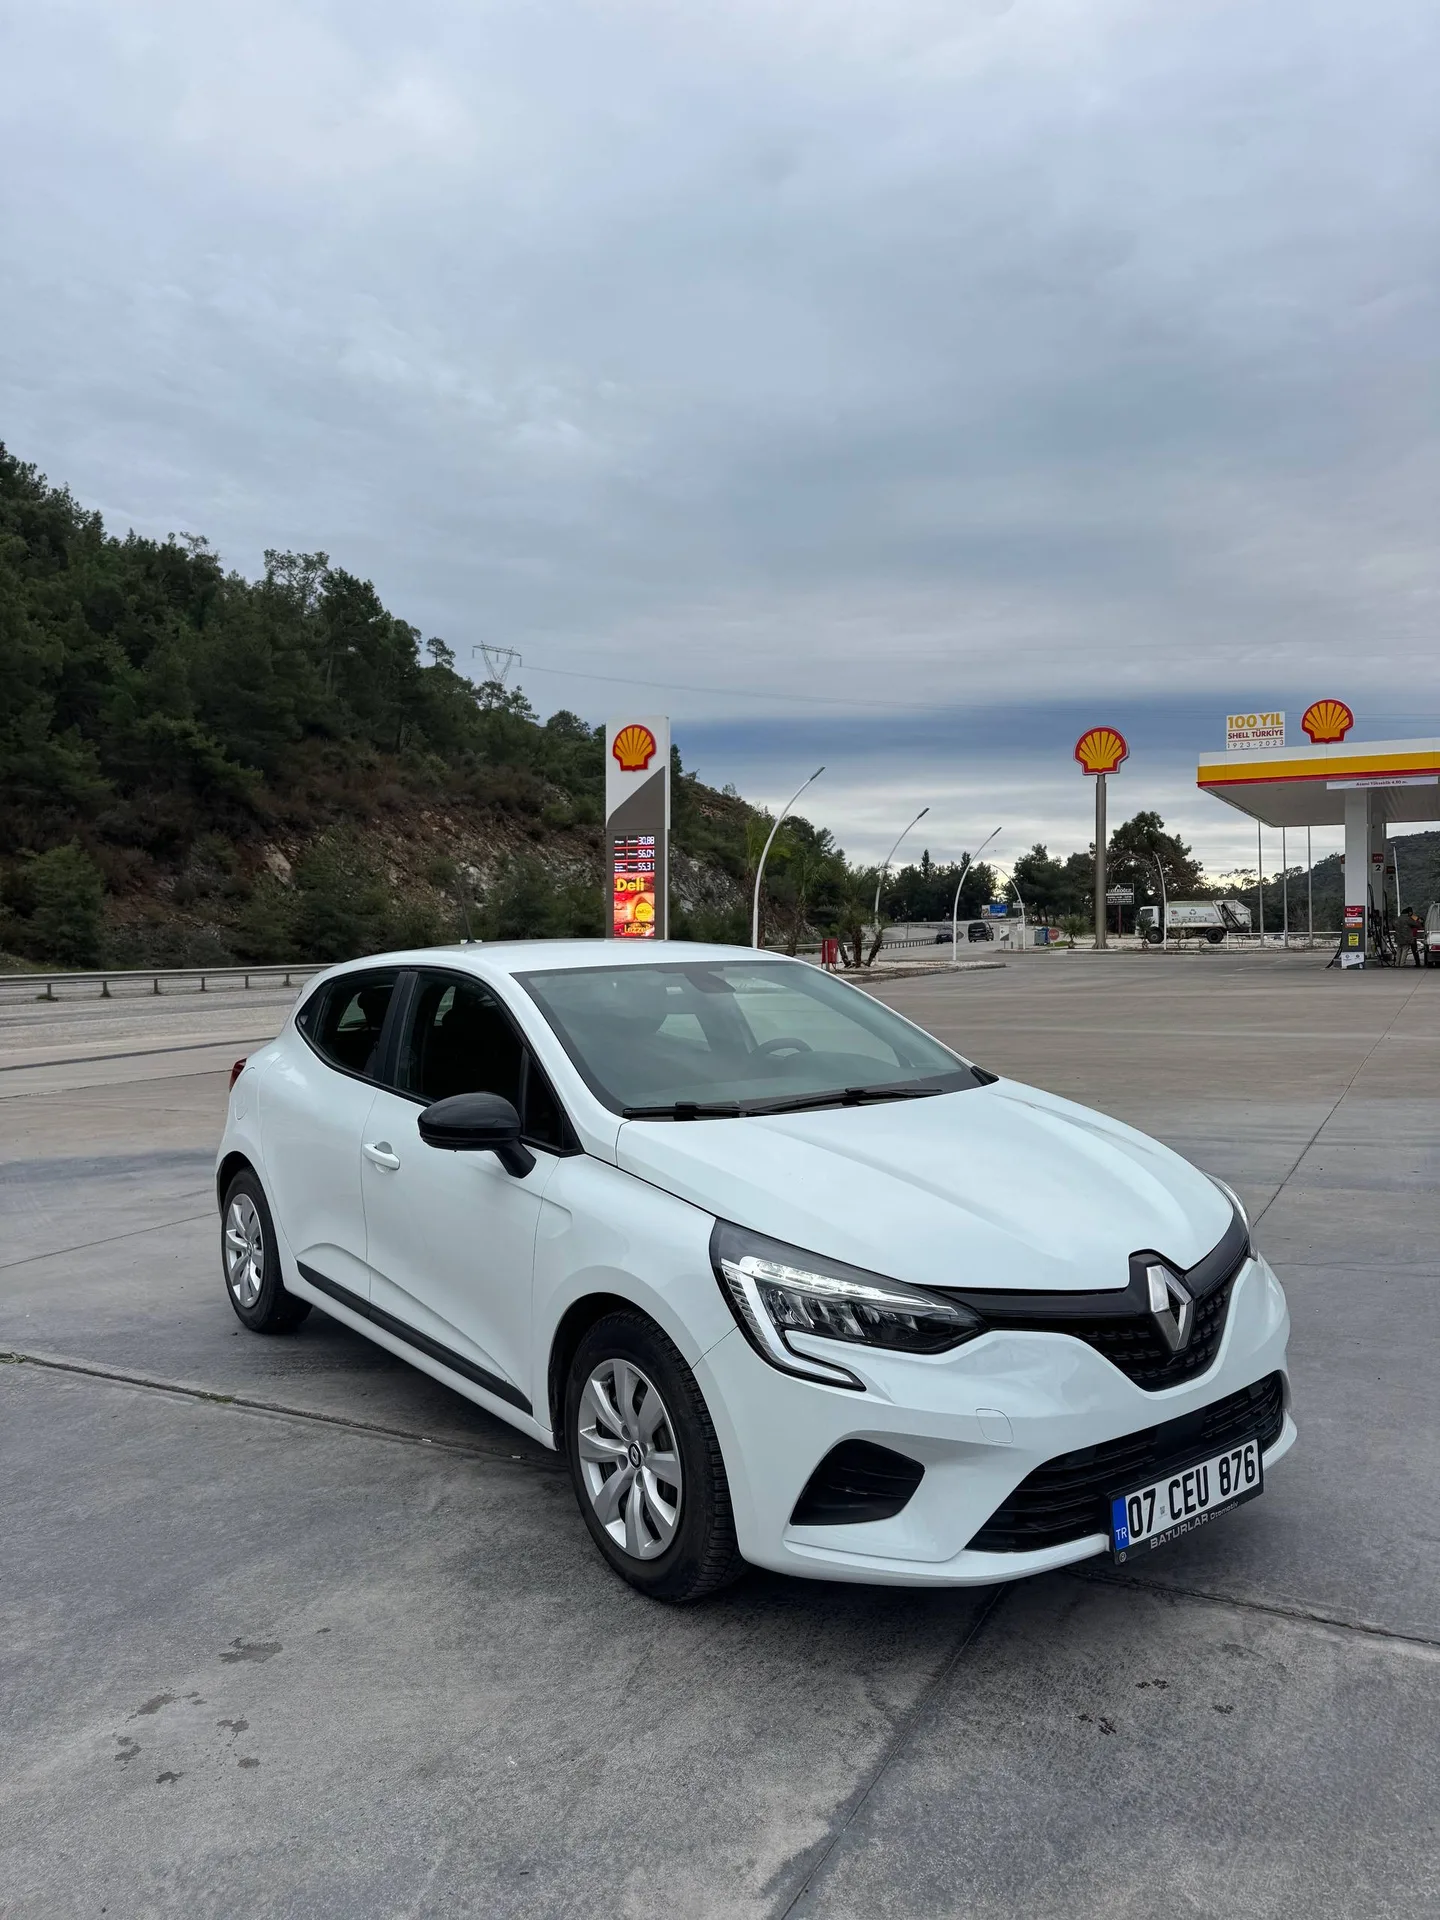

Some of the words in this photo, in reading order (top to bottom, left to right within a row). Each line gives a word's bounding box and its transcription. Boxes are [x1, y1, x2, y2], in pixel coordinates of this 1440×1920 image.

[1228, 714, 1257, 729] 100
[1259, 712, 1284, 727] YIL
[1227, 731, 1250, 740] SHELL
[1251, 727, 1284, 738] TÜRKİYE
[616, 877, 645, 892] Deli
[1128, 1487, 1156, 1539] 07
[1168, 1465, 1210, 1521] CEU
[1218, 1444, 1256, 1497] 876
[1115, 1527, 1128, 1541] TR
[1150, 1513, 1209, 1550] BATURLAR
